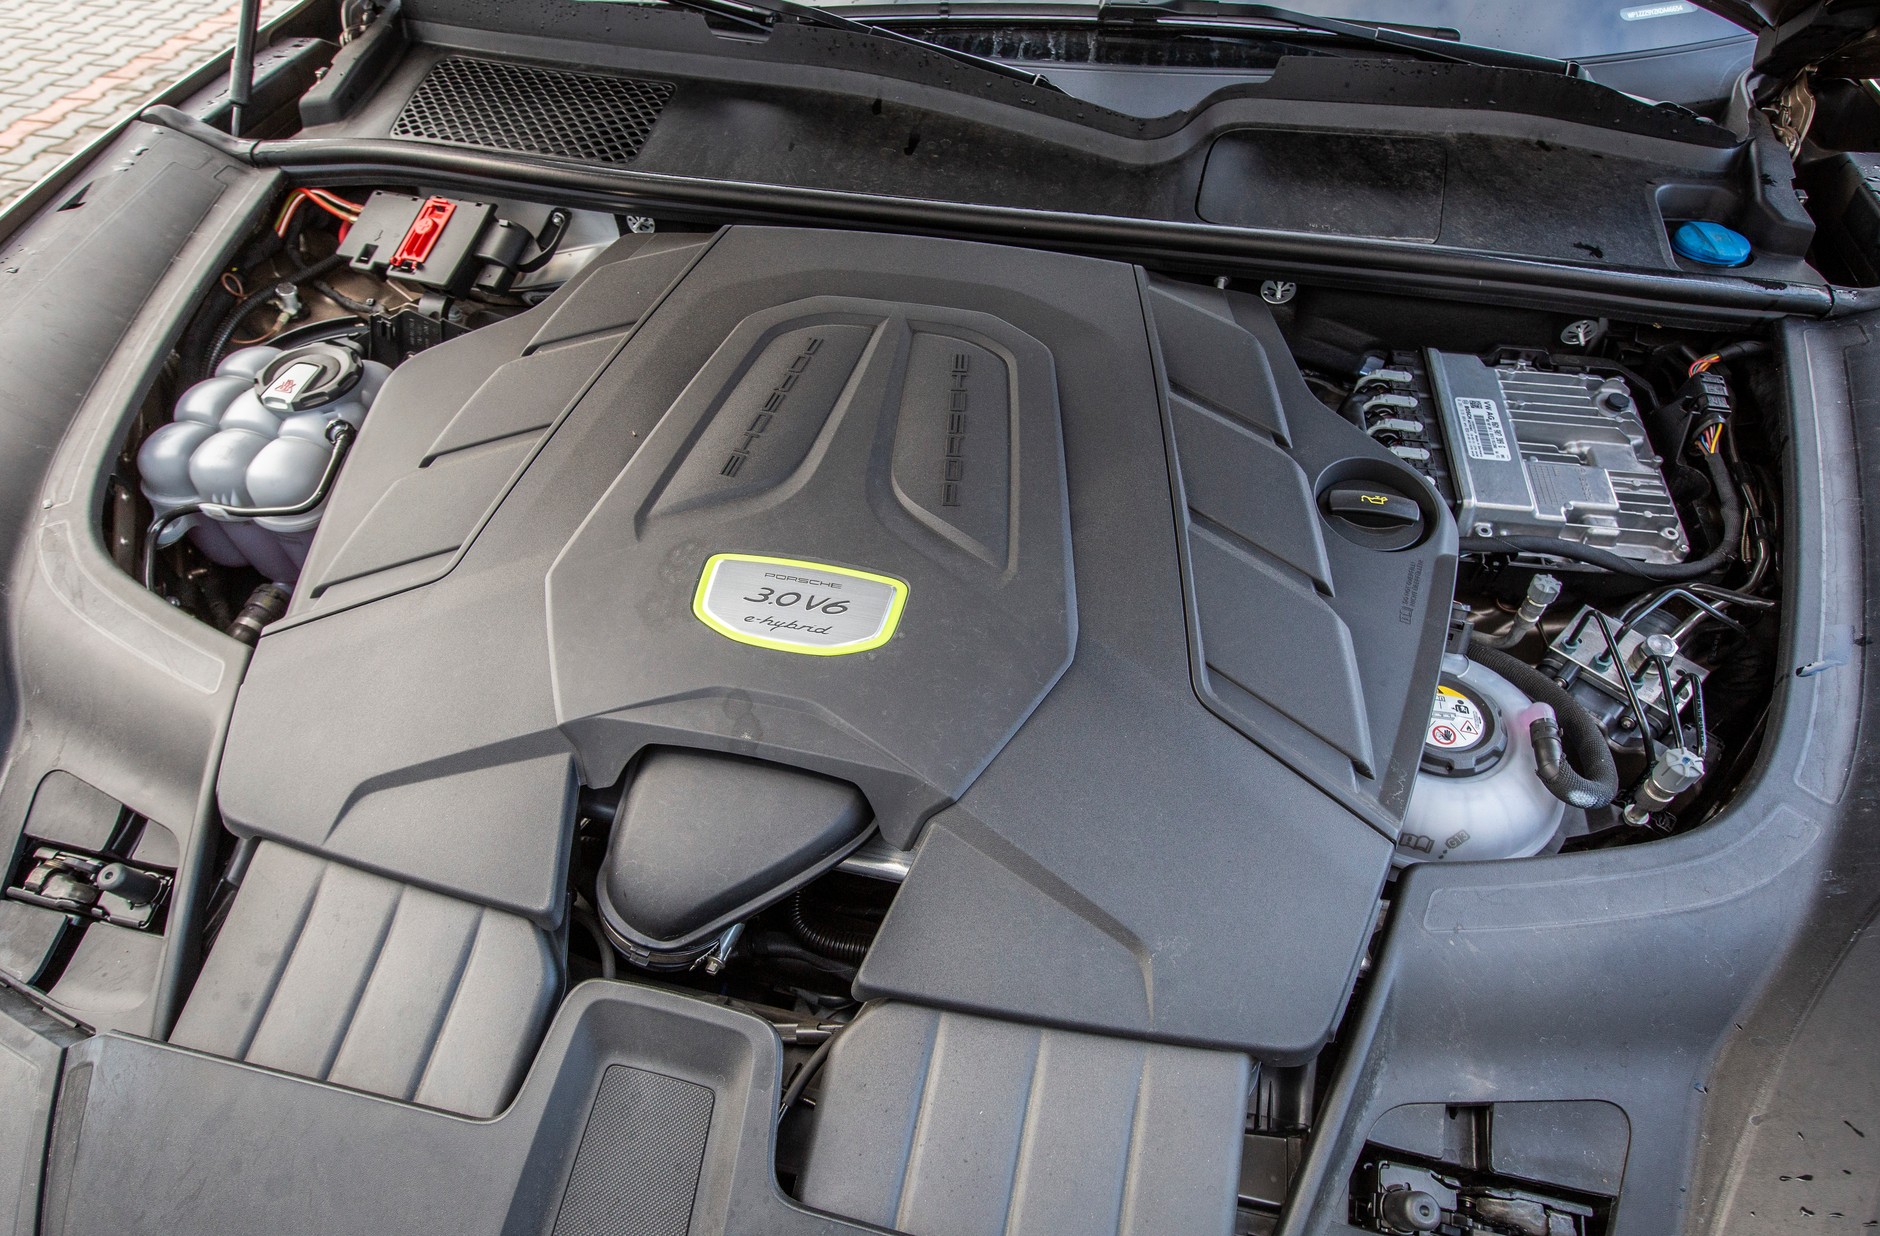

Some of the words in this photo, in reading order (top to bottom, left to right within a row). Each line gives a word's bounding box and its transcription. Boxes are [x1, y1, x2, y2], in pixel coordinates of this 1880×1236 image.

[720, 337, 824, 477] PORSCHE
[942, 353, 970, 507] PORSCHE
[764, 572, 843, 590] PORSCHE
[744, 615, 833, 636] e-hybrid
[1447, 830, 1470, 849] G13
